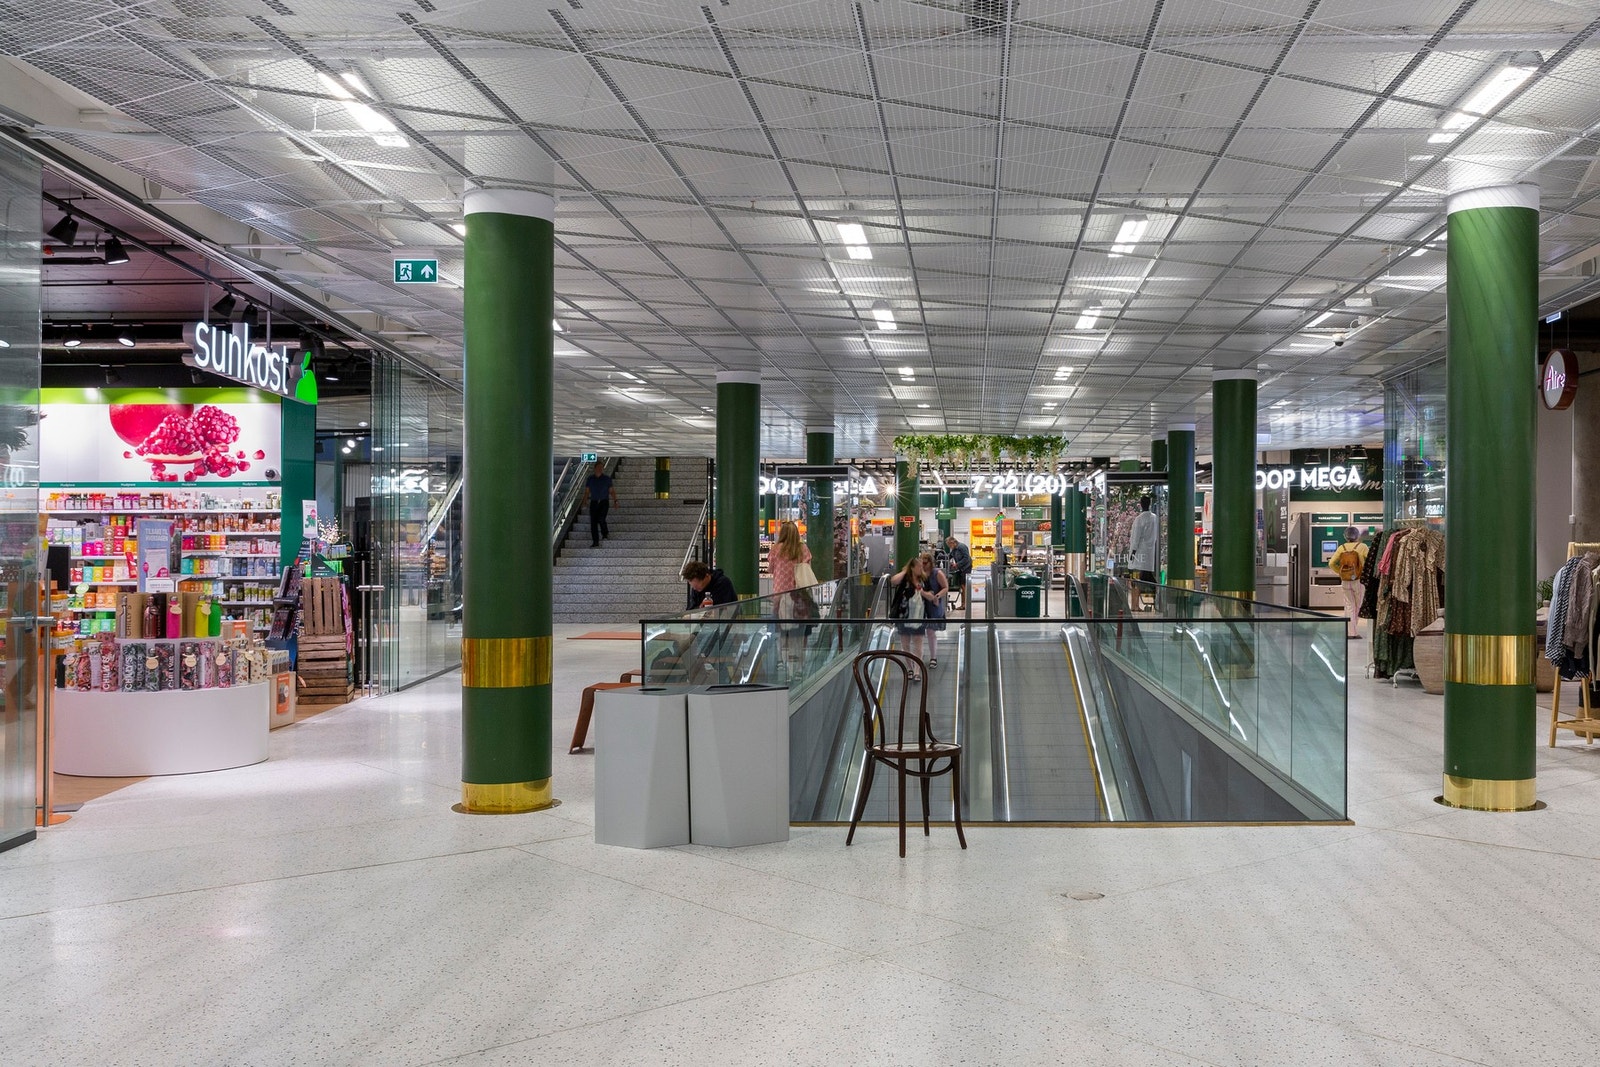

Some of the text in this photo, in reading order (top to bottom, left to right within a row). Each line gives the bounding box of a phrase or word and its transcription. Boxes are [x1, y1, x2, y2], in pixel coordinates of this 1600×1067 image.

[195, 321, 289, 395] sunkost
[971, 473, 1067, 496] 7-22 (20)
[1300, 465, 1362, 488] MEGA
